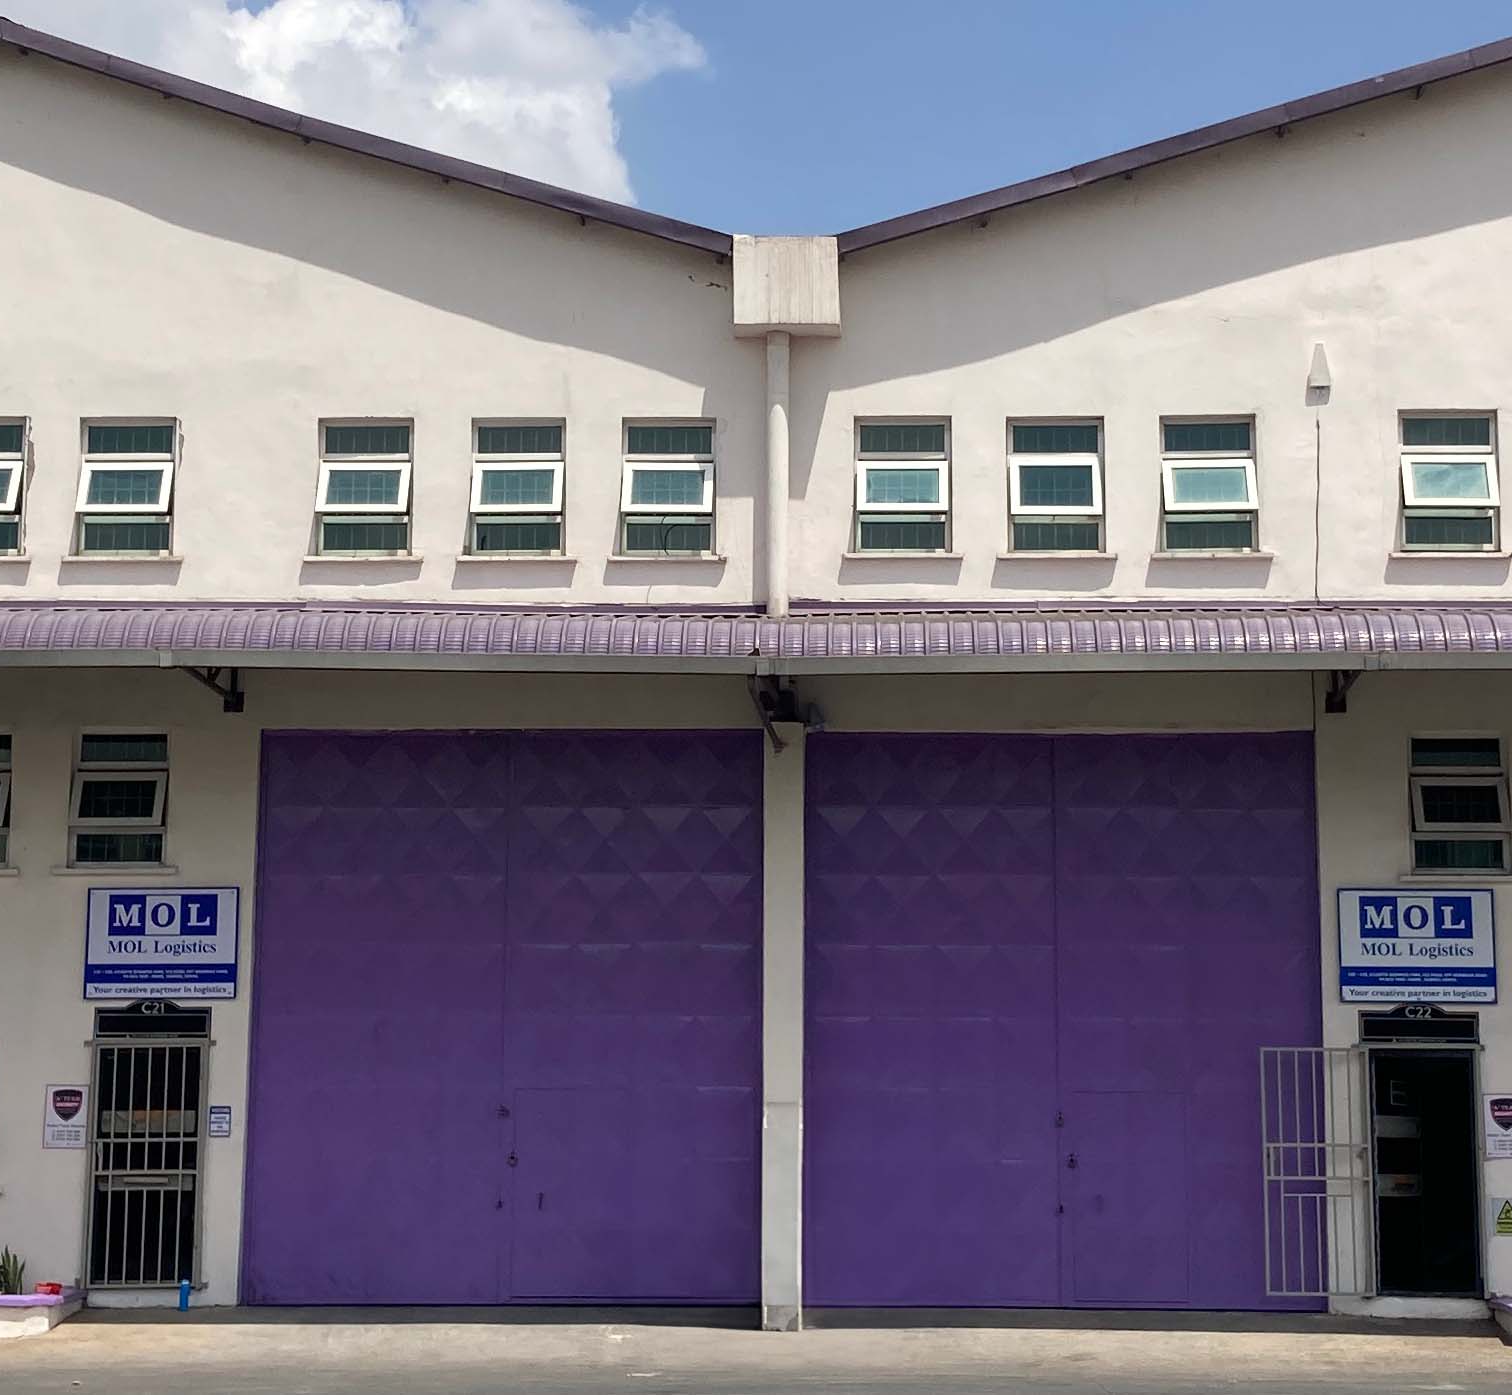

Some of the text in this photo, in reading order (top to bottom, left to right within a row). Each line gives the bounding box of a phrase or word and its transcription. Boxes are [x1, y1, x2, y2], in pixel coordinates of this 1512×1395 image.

[112, 902, 211, 928] MOL
[1363, 904, 1466, 930] MOL
[107, 940, 217, 957] MOL Logistics
[1360, 942, 1474, 960] MOL Logistics
[93, 985, 227, 996] Your creative partner in logistics
[1349, 988, 1487, 1000] Your creative partner in logistics
[141, 1002, 165, 1014] C21
[1405, 1006, 1432, 1018] C22
